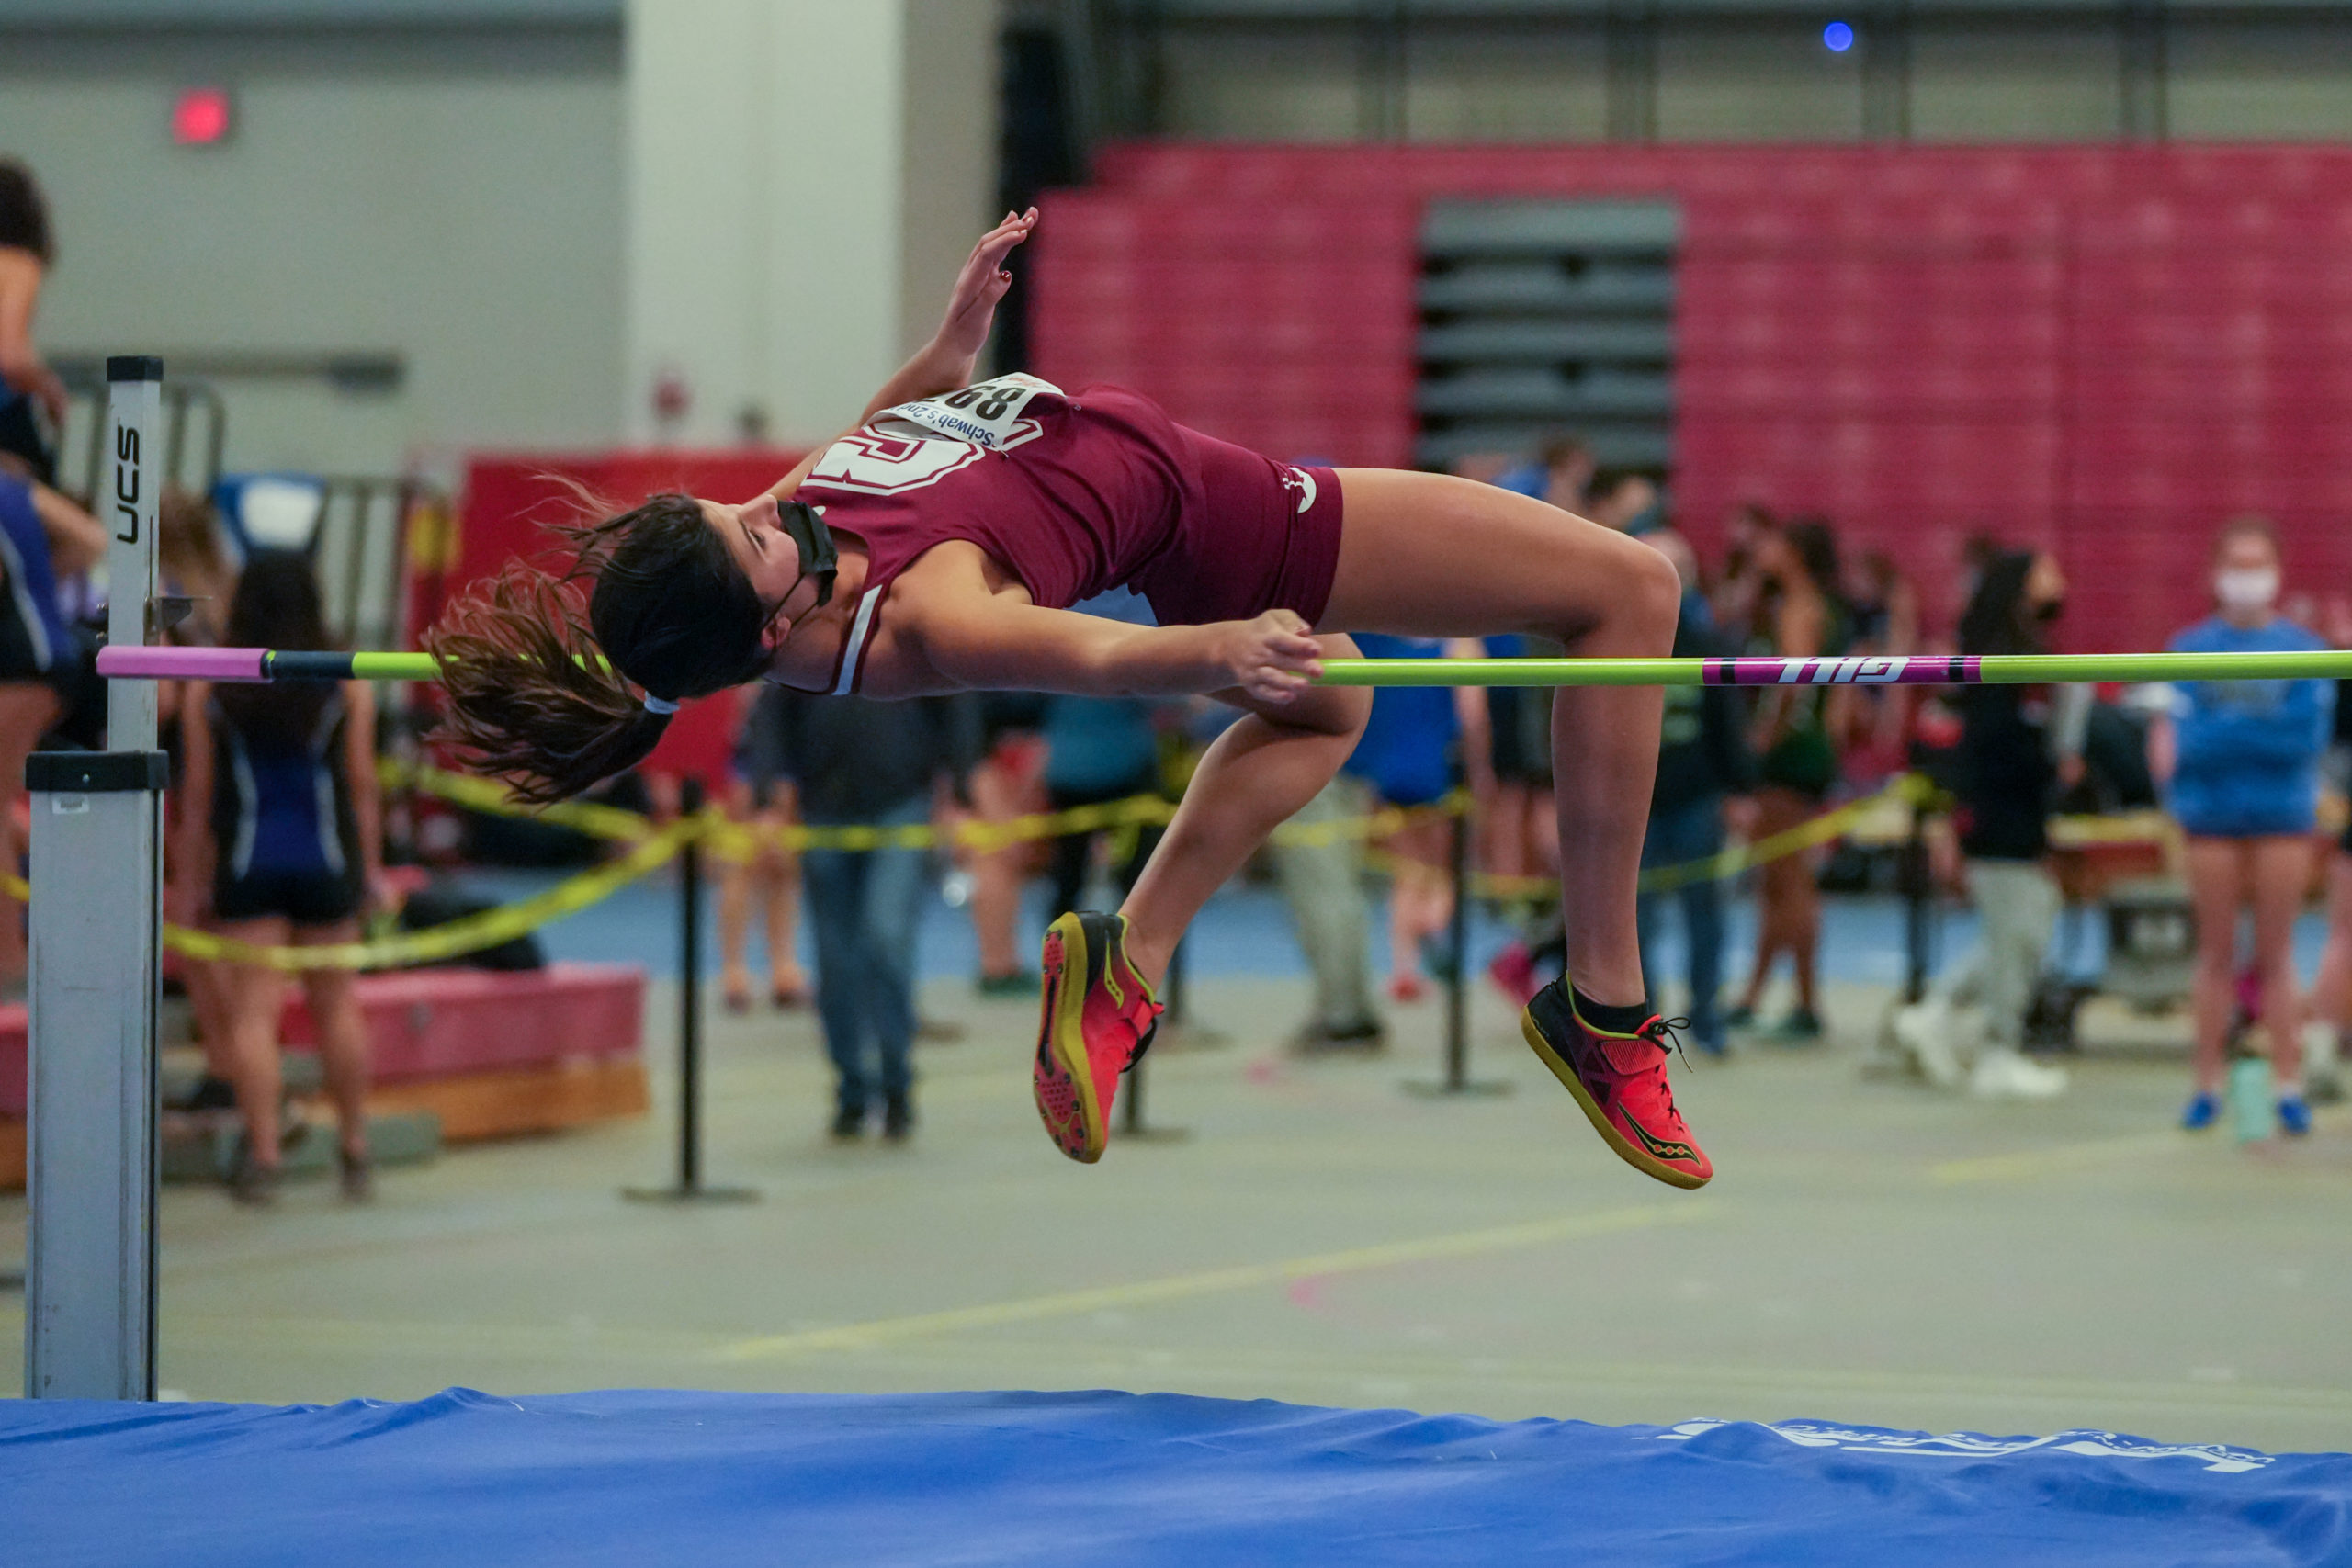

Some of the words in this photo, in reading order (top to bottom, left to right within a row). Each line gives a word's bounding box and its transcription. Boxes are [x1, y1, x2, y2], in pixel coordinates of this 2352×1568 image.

[927, 410, 995, 446] Schwab's
[117, 423, 140, 545] UCS
[1777, 656, 1910, 683] GILL
